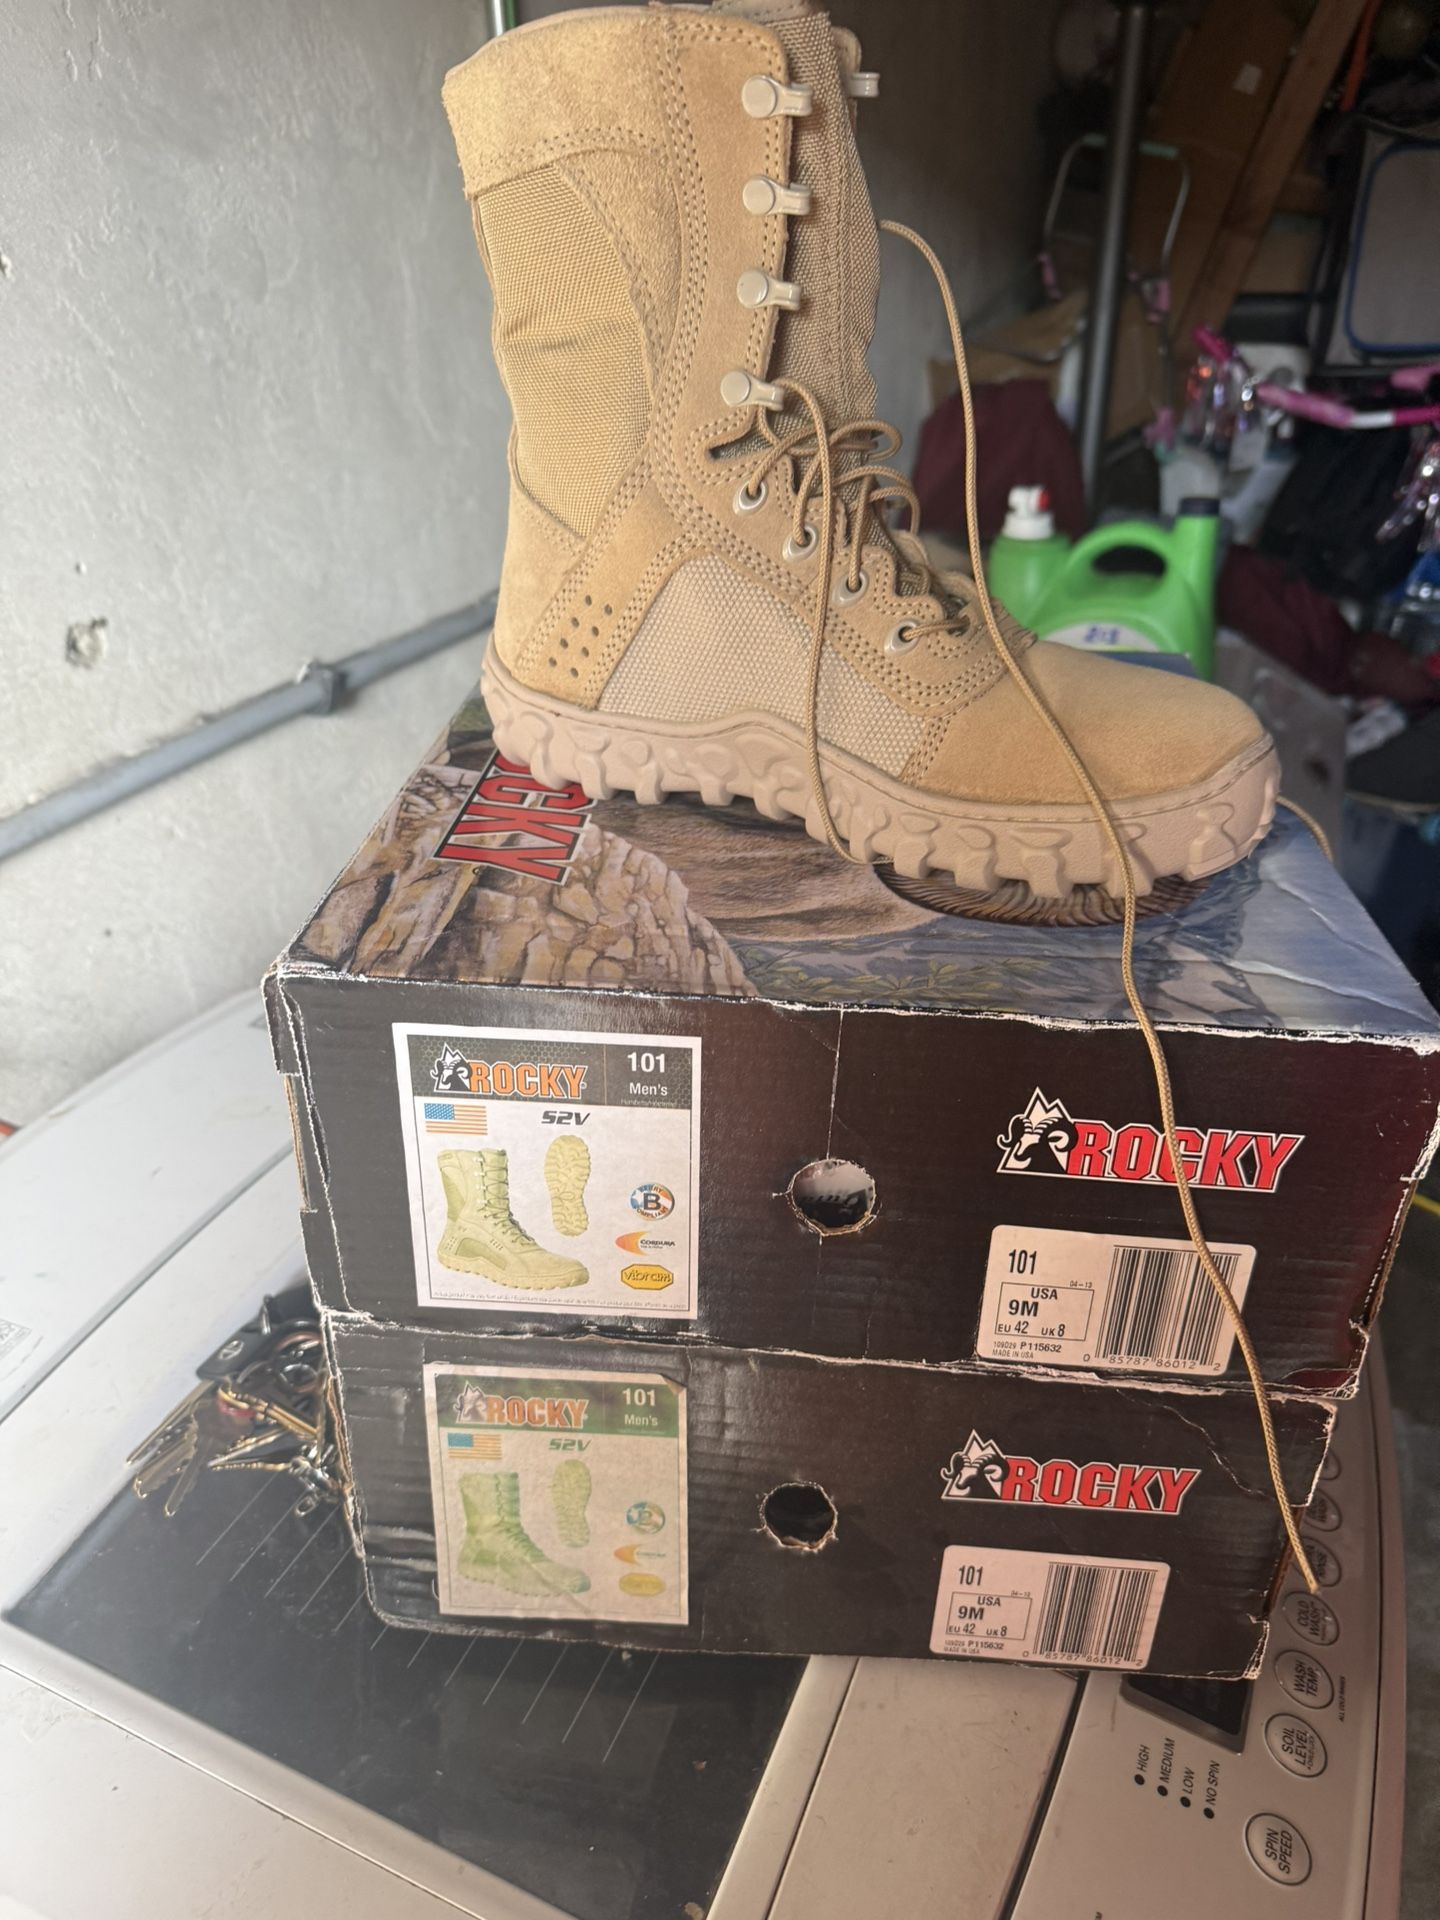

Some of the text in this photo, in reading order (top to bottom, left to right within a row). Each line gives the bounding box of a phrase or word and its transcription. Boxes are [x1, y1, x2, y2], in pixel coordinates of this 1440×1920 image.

[434, 750, 598, 886] CKY
[627, 1052, 666, 1073] 101
[470, 1061, 588, 1098] ROCKY
[629, 1081, 668, 1097] Men's
[1067, 1121, 1304, 1192] ROCKY
[643, 1192, 662, 1211] B
[1009, 1249, 1037, 1275] 101
[1030, 1287, 1058, 1300] USA
[1008, 1299, 1039, 1318] 9M
[998, 1320, 1066, 1337] EU 42 UK 8
[992, 1349, 1011, 1357] MADE
[1021, 1351, 1034, 1359] USA
[1109, 1356, 1149, 1366] 85787
[1155, 1358, 1196, 1370] 86012
[1213, 1363, 1221, 1371] 2
[621, 1388, 656, 1407] 101
[486, 1396, 590, 1429] ROCKY
[624, 1414, 658, 1426] Men's
[1001, 1456, 1200, 1515] ROCKY
[958, 1565, 984, 1586] 101
[957, 1605, 984, 1621] 9M
[977, 1596, 1001, 1607] USA
[948, 1623, 1008, 1637] EU 42 UK 8
[1086, 1654, 1121, 1665] 86012
[1294, 1660, 1306, 1693] WASH
[1281, 1728, 1295, 1754] SOIL
[1295, 1729, 1308, 1765] LEVEL
[1137, 1745, 1150, 1773] HIGH
[1160, 1738, 1175, 1784] MEDIUM
[1183, 1767, 1195, 1796] LOW
[1206, 1760, 1220, 1806] NO SPIN
[1265, 1828, 1279, 1860] SPIN
[1279, 1830, 1293, 1874] SPEED
